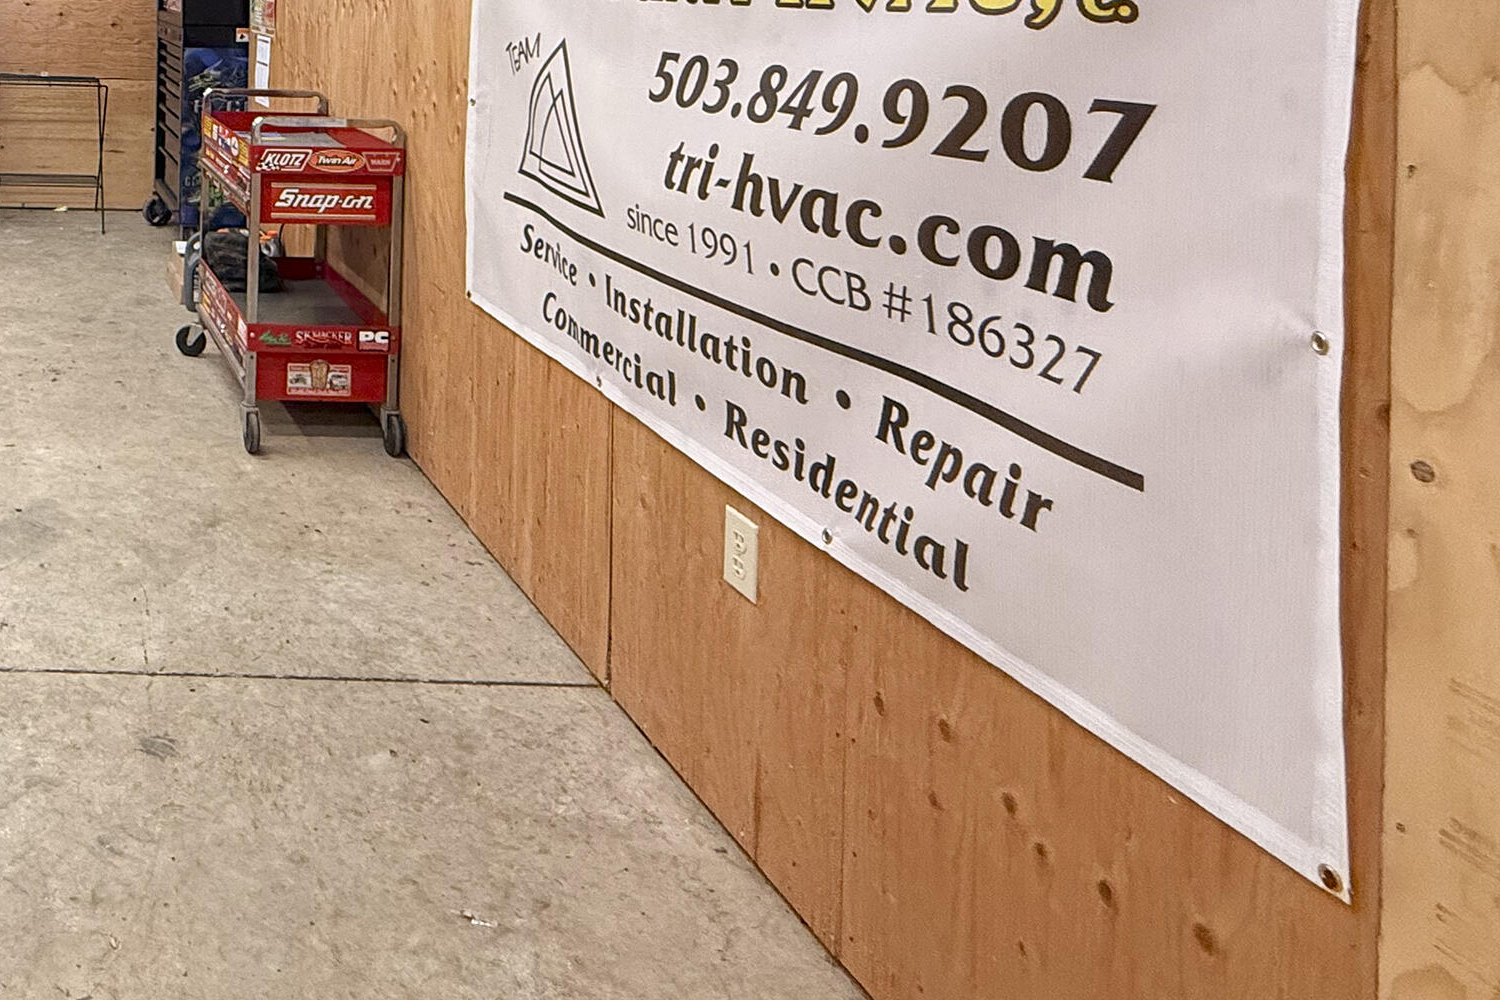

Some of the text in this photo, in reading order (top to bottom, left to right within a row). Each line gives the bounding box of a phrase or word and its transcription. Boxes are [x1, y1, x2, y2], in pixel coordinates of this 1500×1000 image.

[505, 32, 541, 76] TEAM
[264, 152, 307, 166] KLOTZ
[317, 155, 358, 166] Twin Air
[648, 51, 1158, 184] 503.849.9207
[274, 188, 374, 214] Snap-on
[663, 141, 1115, 313] tri-hvac.com
[358, 331, 390, 344] PC
[626, 203, 1103, 394] since 1991 CCB #186327
[520, 223, 1055, 533] Service Installation Repair
[542, 291, 970, 592] Commercial Residential
